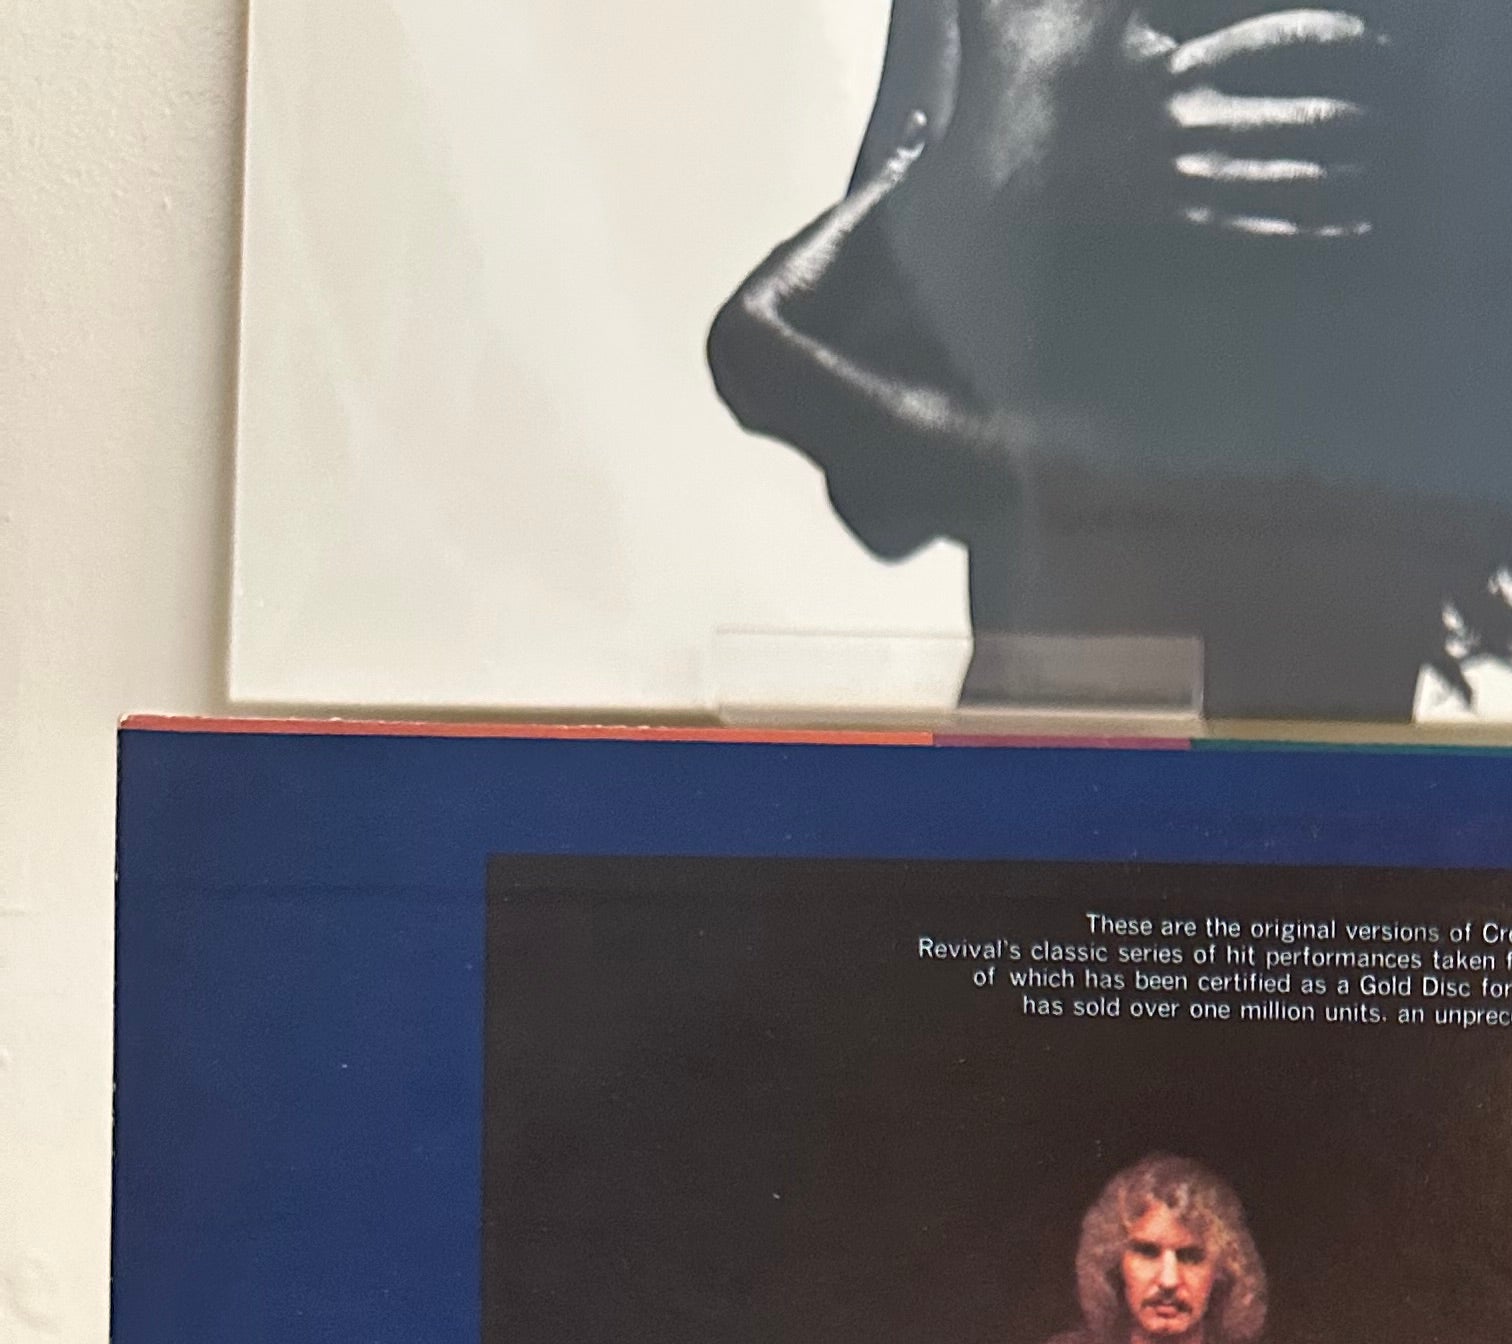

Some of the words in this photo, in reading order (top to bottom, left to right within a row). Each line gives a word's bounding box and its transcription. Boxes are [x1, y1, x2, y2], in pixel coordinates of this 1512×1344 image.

[1086, 913, 1153, 936] These
[1161, 920, 1197, 937] are
[1206, 917, 1241, 938] the
[1250, 919, 1336, 943] original
[1345, 925, 1439, 941] versions
[1449, 922, 1472, 943] of
[918, 937, 1021, 960] Revival's
[1031, 940, 1107, 962] classic
[1118, 947, 1183, 964] series
[1193, 943, 1216, 964] of
[1227, 944, 1255, 966] hit
[1266, 945, 1422, 970] performances
[1433, 949, 1495, 971] taken
[973, 966, 995, 986] of
[1009, 967, 1075, 988] which
[1085, 969, 1125, 990] has
[1135, 970, 1188, 991] been
[1198, 972, 1291, 993] certified
[1301, 979, 1327, 995] as
[1337, 979, 1349, 995] a
[1360, 974, 1411, 996] Gold
[1422, 976, 1470, 997] Disc
[1482, 977, 1512, 998] for
[1023, 995, 1063, 1016] has
[1073, 996, 1120, 1017] sold
[1130, 1002, 1180, 1018] over
[1189, 1003, 1231, 1019] one
[1240, 1000, 1315, 1021] million
[1398, 1008, 1424, 1024] an
